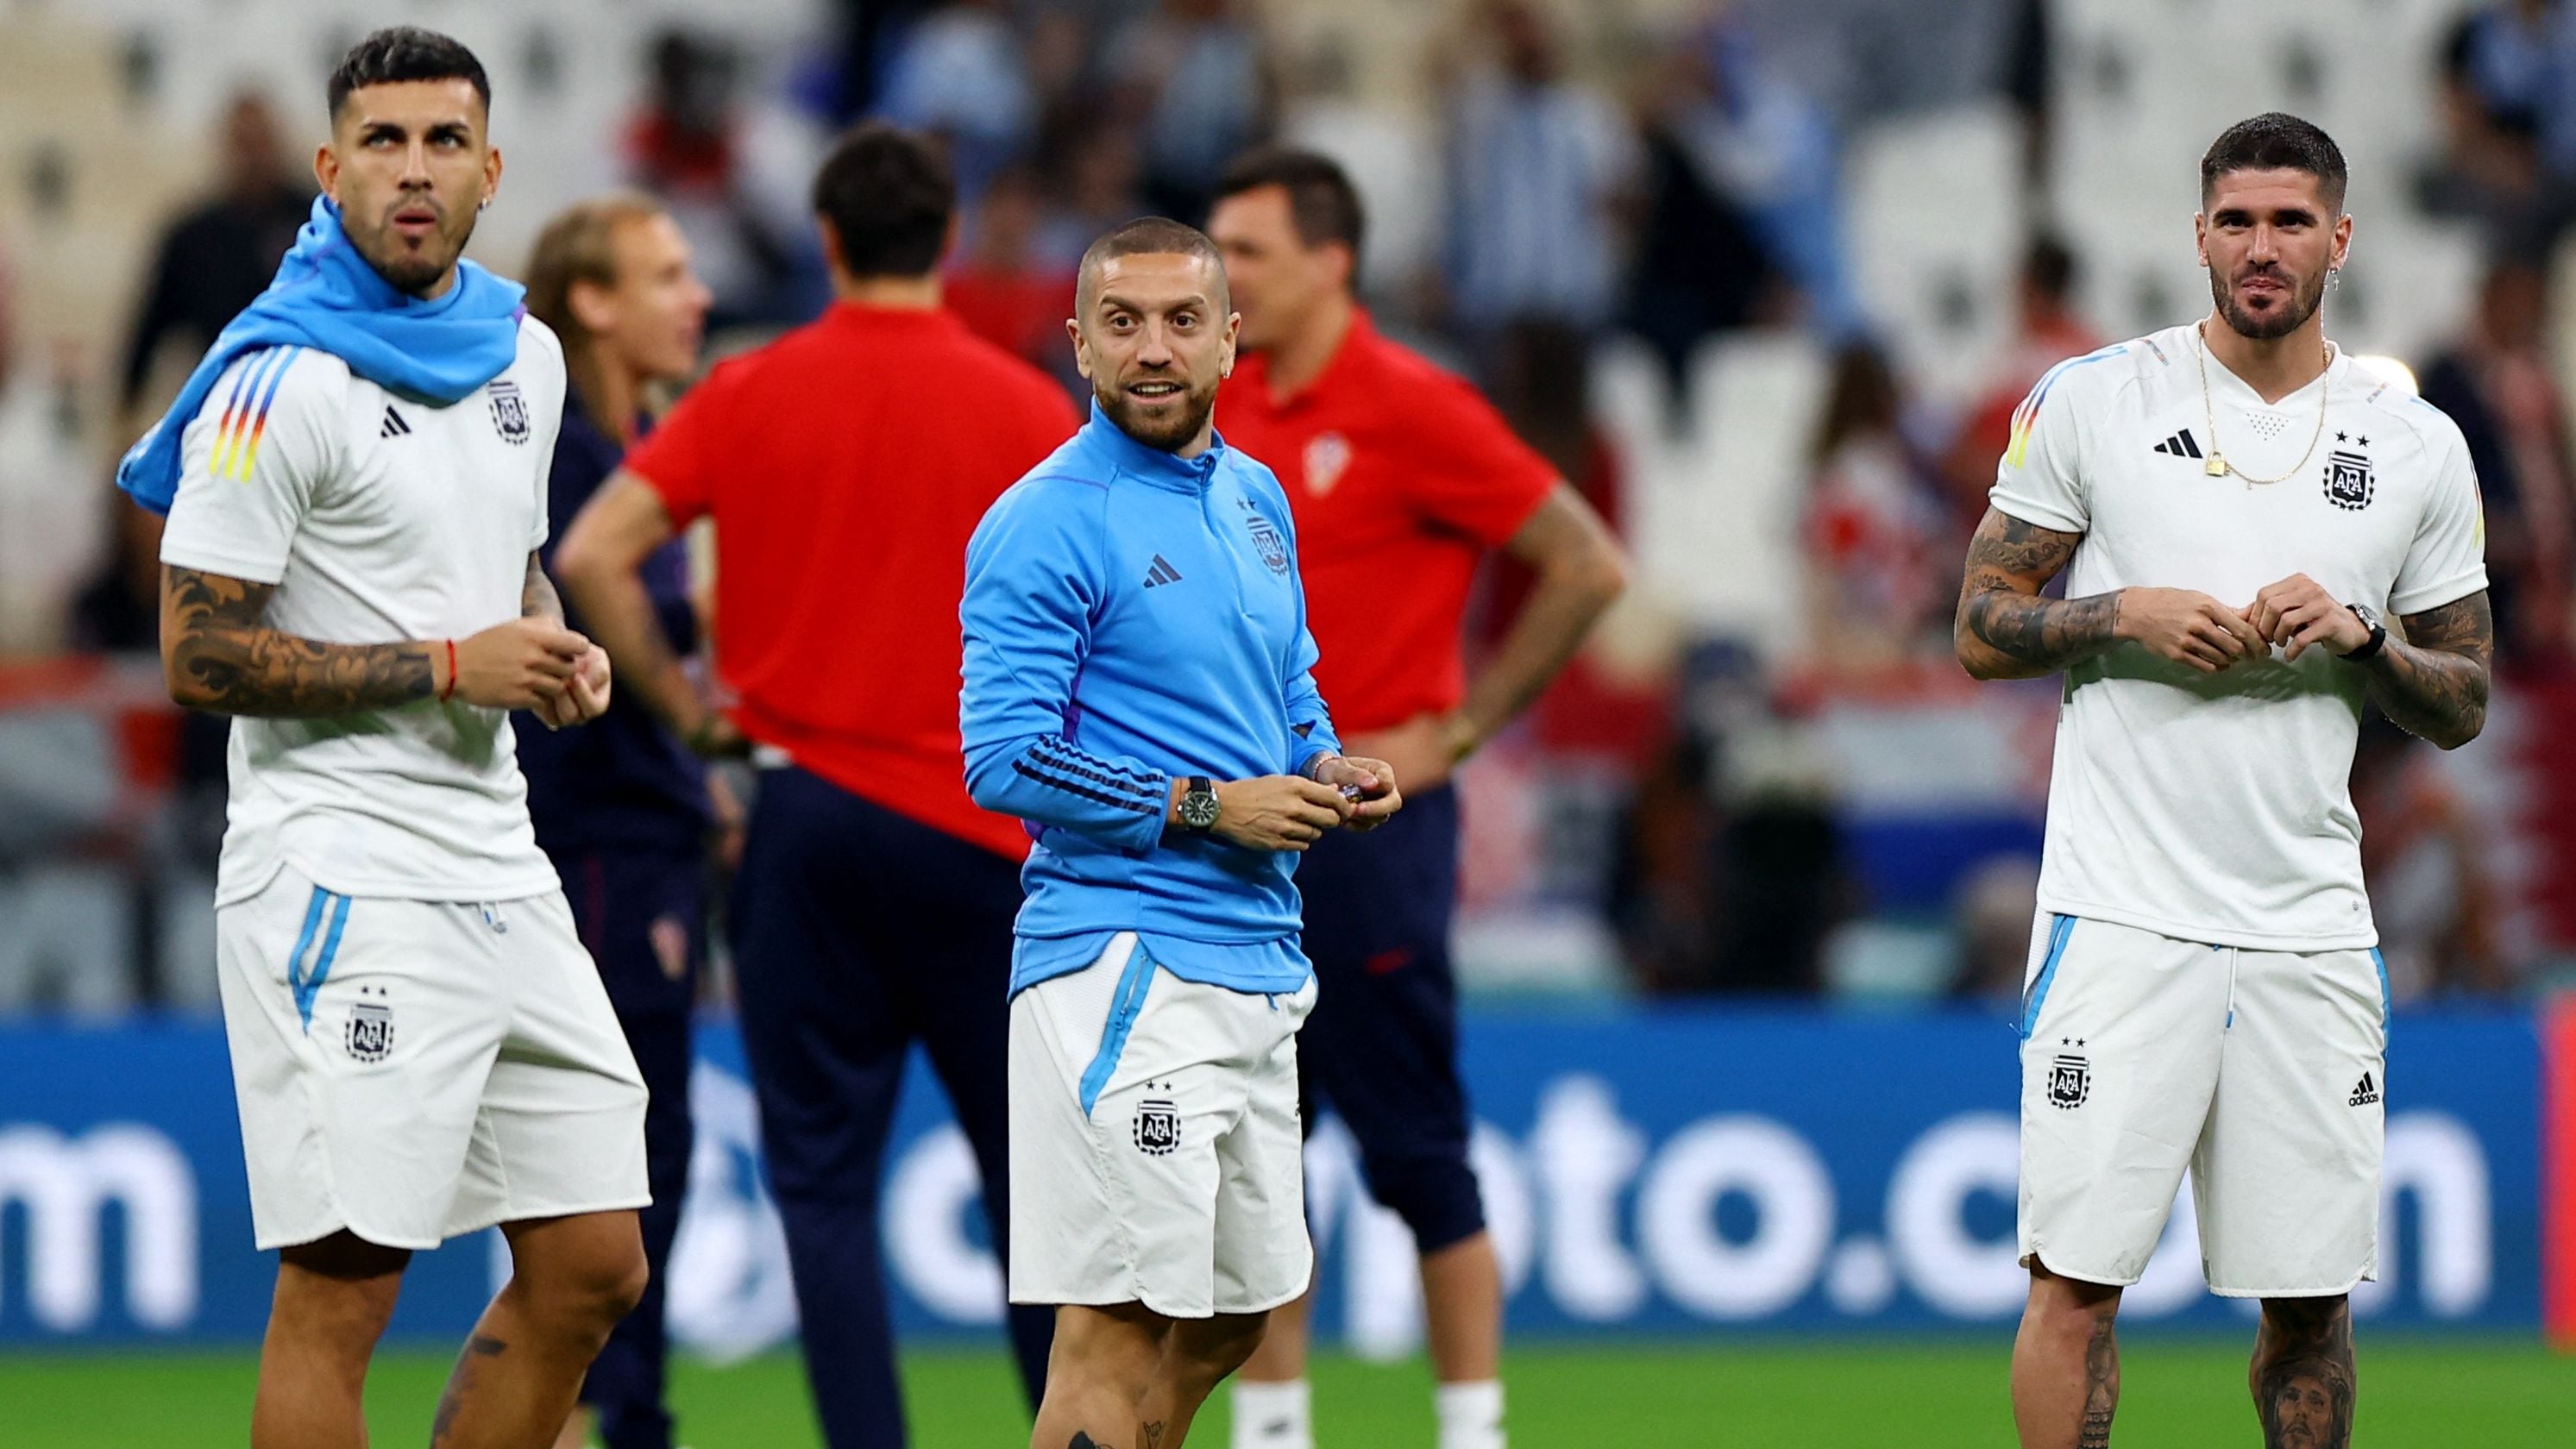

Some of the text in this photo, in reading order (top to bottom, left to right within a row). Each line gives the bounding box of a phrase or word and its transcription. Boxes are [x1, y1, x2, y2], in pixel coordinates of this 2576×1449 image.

[2334, 467, 2364, 496] AFA
[2056, 1070, 2080, 1095] AFA
[2348, 1092, 2379, 1107] adidas
[1144, 1114, 1172, 1142] AFA
